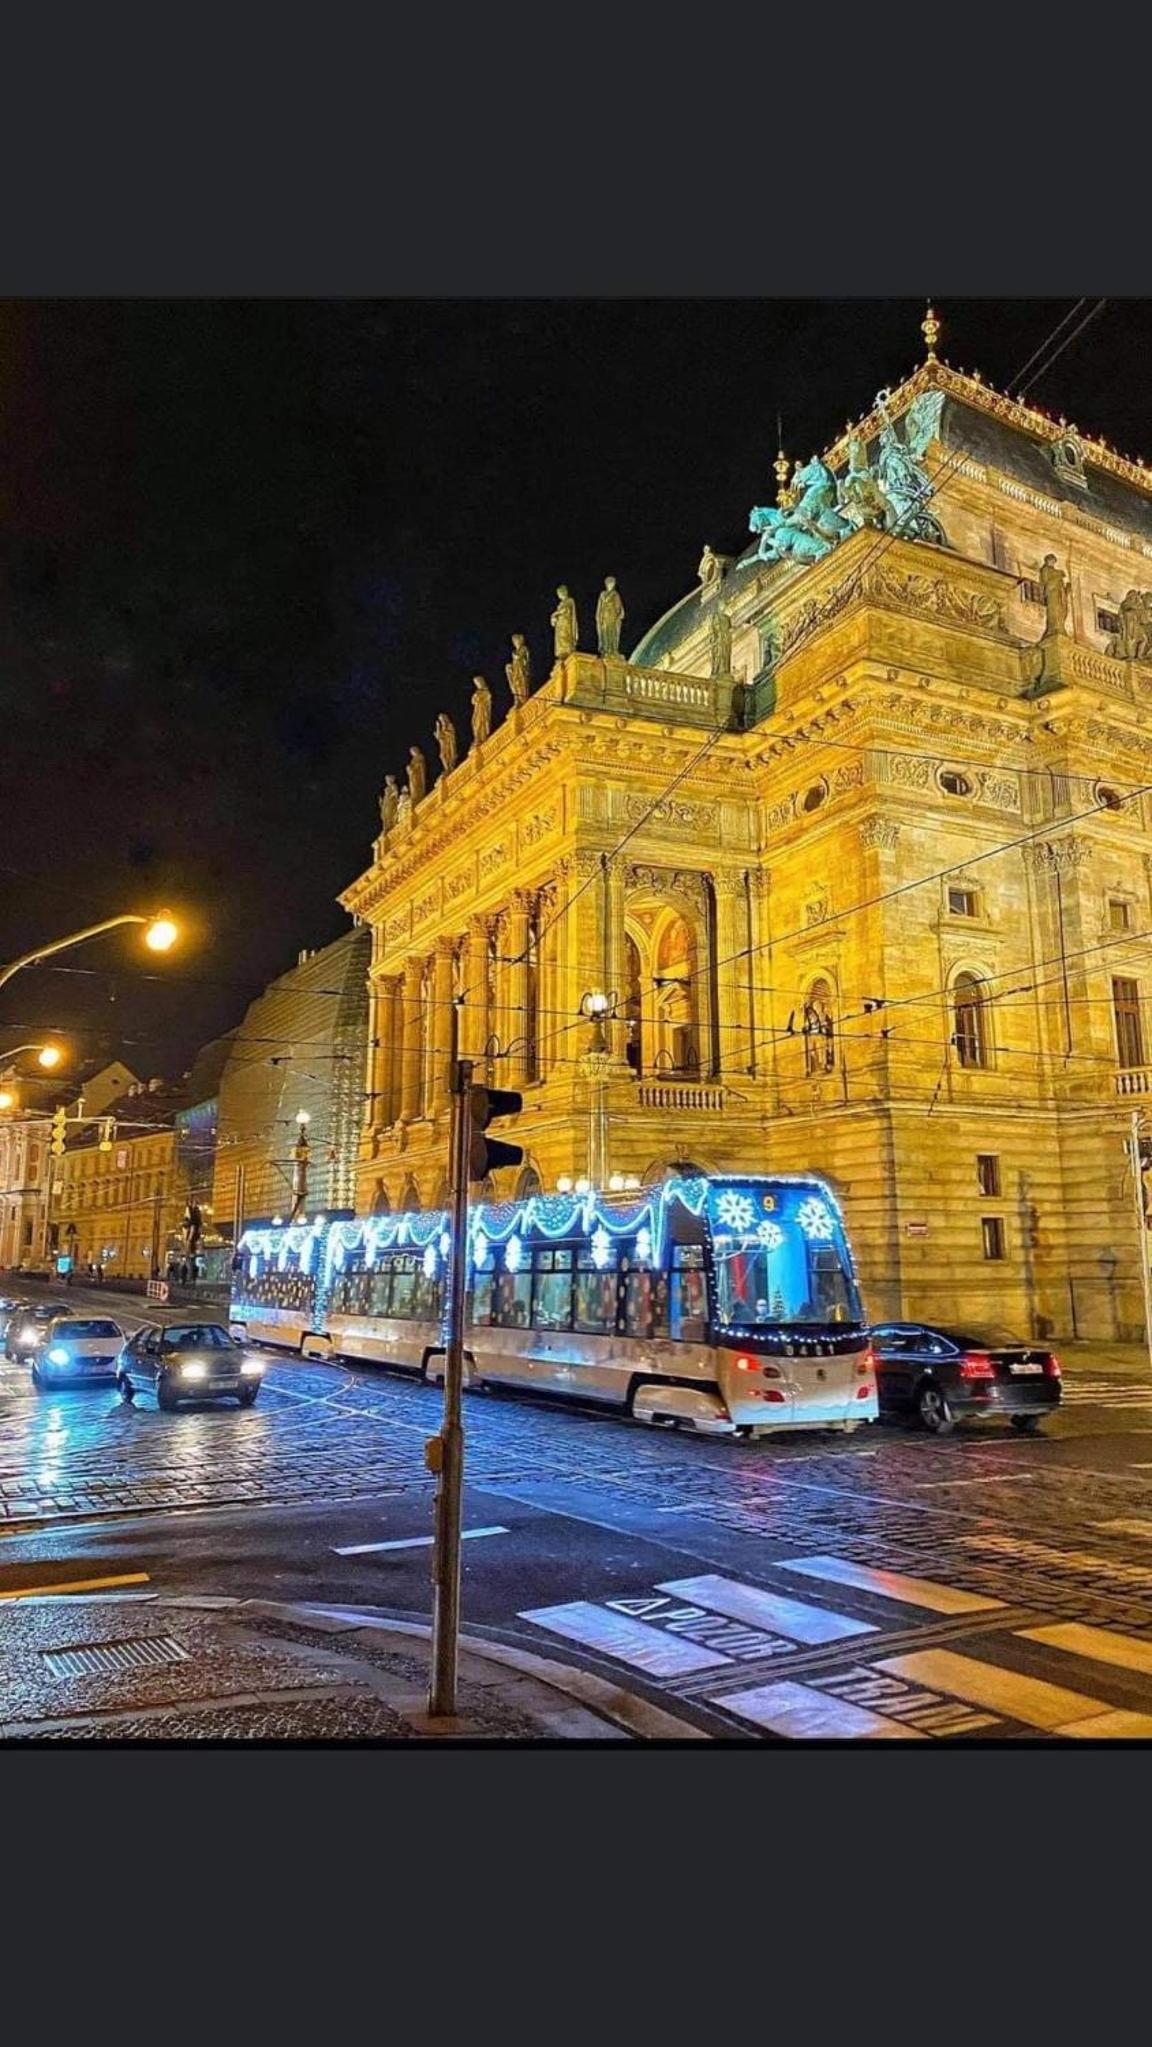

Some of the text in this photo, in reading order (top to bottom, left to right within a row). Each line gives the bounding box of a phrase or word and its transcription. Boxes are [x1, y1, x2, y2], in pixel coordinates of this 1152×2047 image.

[763, 1195, 775, 1211] 9
[641, 1607, 1003, 1737] POZOR TRAM
